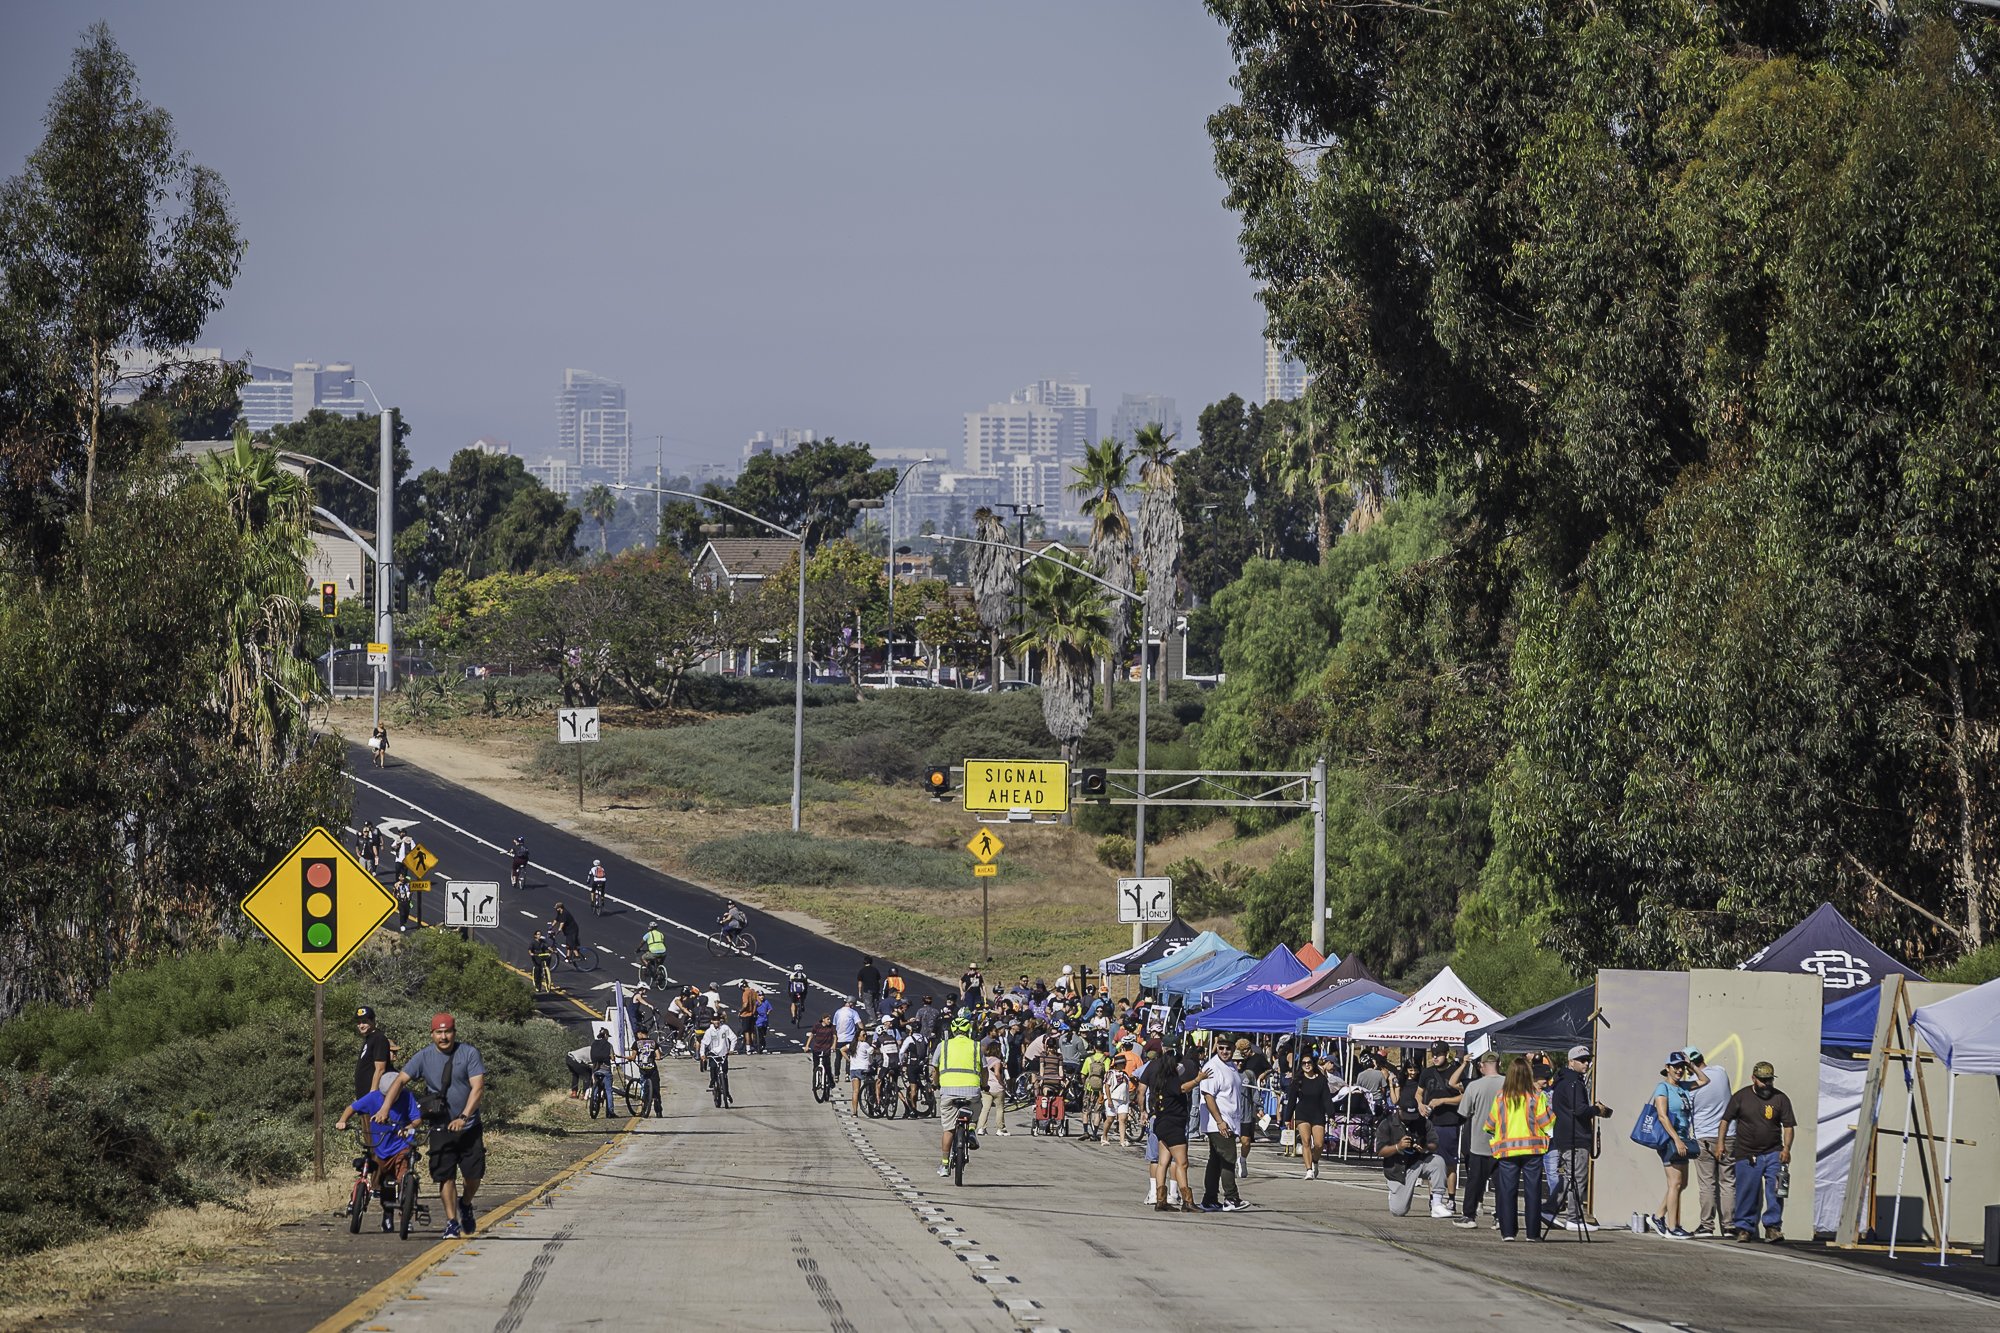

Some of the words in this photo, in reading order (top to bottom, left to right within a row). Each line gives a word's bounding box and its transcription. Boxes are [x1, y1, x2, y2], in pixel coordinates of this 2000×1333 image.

[985, 768, 1047, 783] SIGNAL
[988, 789, 1044, 804] AHEAD
[475, 915, 495, 923] ONLY
[1149, 910, 1168, 918] ONLY
[1419, 996, 1478, 1011] PLANET
[1417, 1005, 1479, 1027] ZOO
